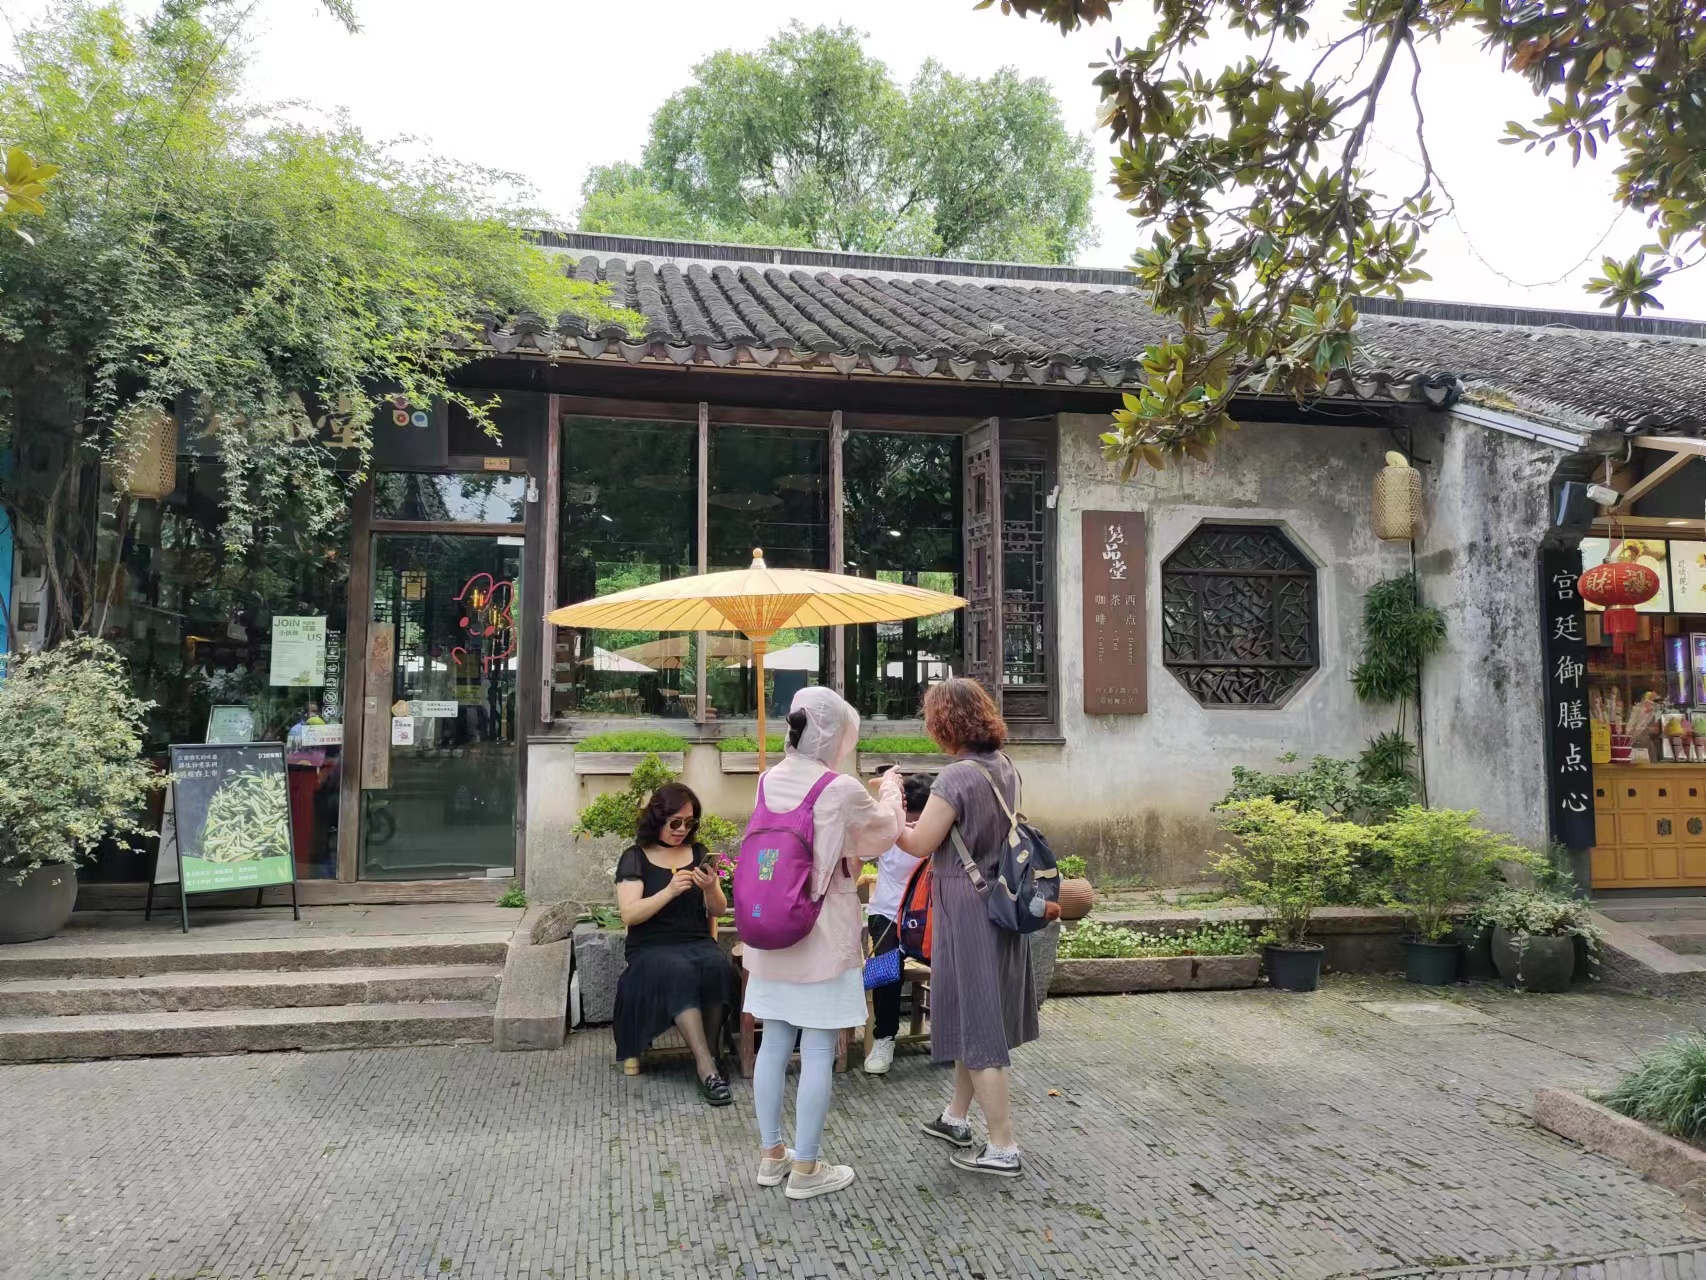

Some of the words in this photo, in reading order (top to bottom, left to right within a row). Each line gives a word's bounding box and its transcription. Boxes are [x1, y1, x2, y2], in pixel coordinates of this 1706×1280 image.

[1095, 594, 1106, 625] 咖啡
[1110, 594, 1121, 606] 茶
[1125, 594, 1137, 625] 西点
[274, 619, 300, 627] JOIN
[307, 633, 323, 641] US
[1552, 570, 1588, 812] 宫廷御膳点心
